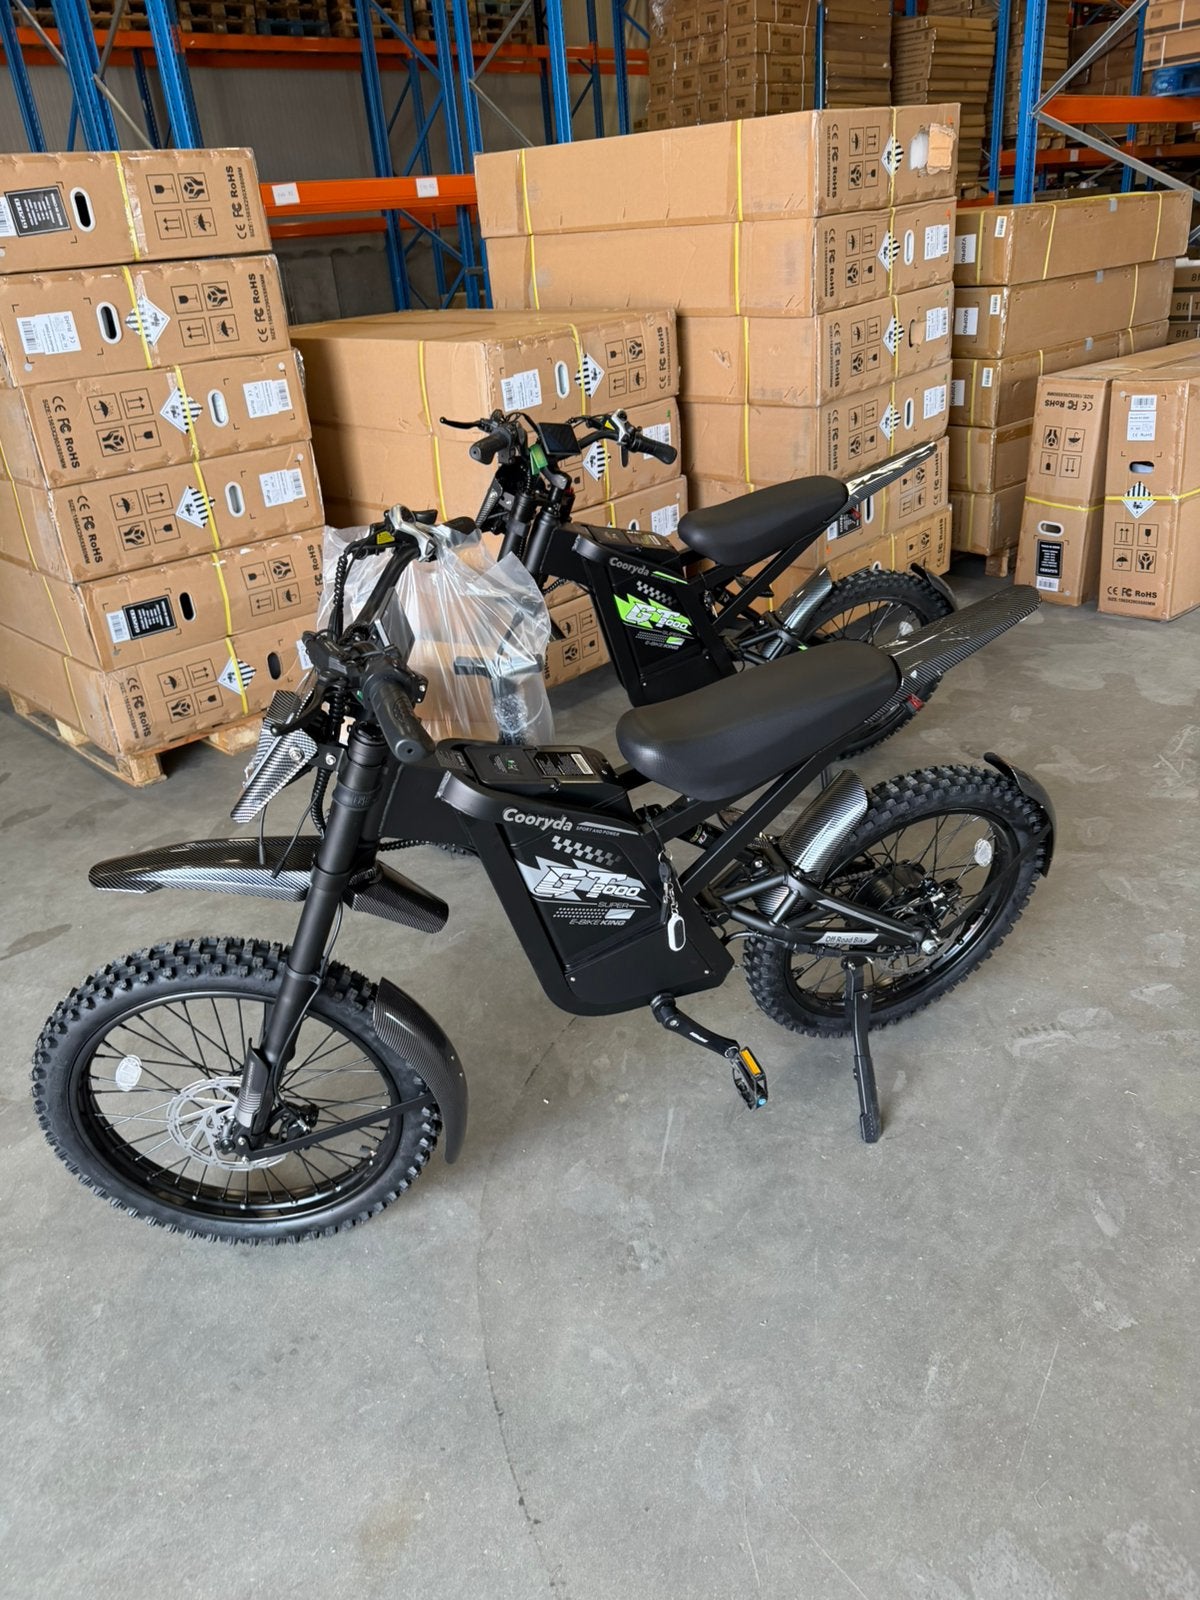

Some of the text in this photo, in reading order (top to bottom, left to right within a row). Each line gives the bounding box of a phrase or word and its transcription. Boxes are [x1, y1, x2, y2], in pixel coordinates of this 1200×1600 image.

[226, 165, 247, 240] CE FC RoHS
[248, 273, 268, 343] CE FC RoHS
[657, 326, 665, 354] RoHS
[659, 375, 666, 389] CE
[1045, 400, 1093, 411] CE FC RoHS
[52, 396, 80, 469] CE FC RoHS
[77, 496, 103, 563] CE FC RoHS
[307, 545, 319, 570] RoHS
[609, 557, 649, 576] Cooryda
[1107, 586, 1157, 599] CE FC RoHS
[126, 677, 140, 692] CE
[139, 712, 151, 737] RoHS
[503, 808, 573, 831] Cooryda
[825, 934, 836, 942] Off
[837, 935, 851, 943] Road
